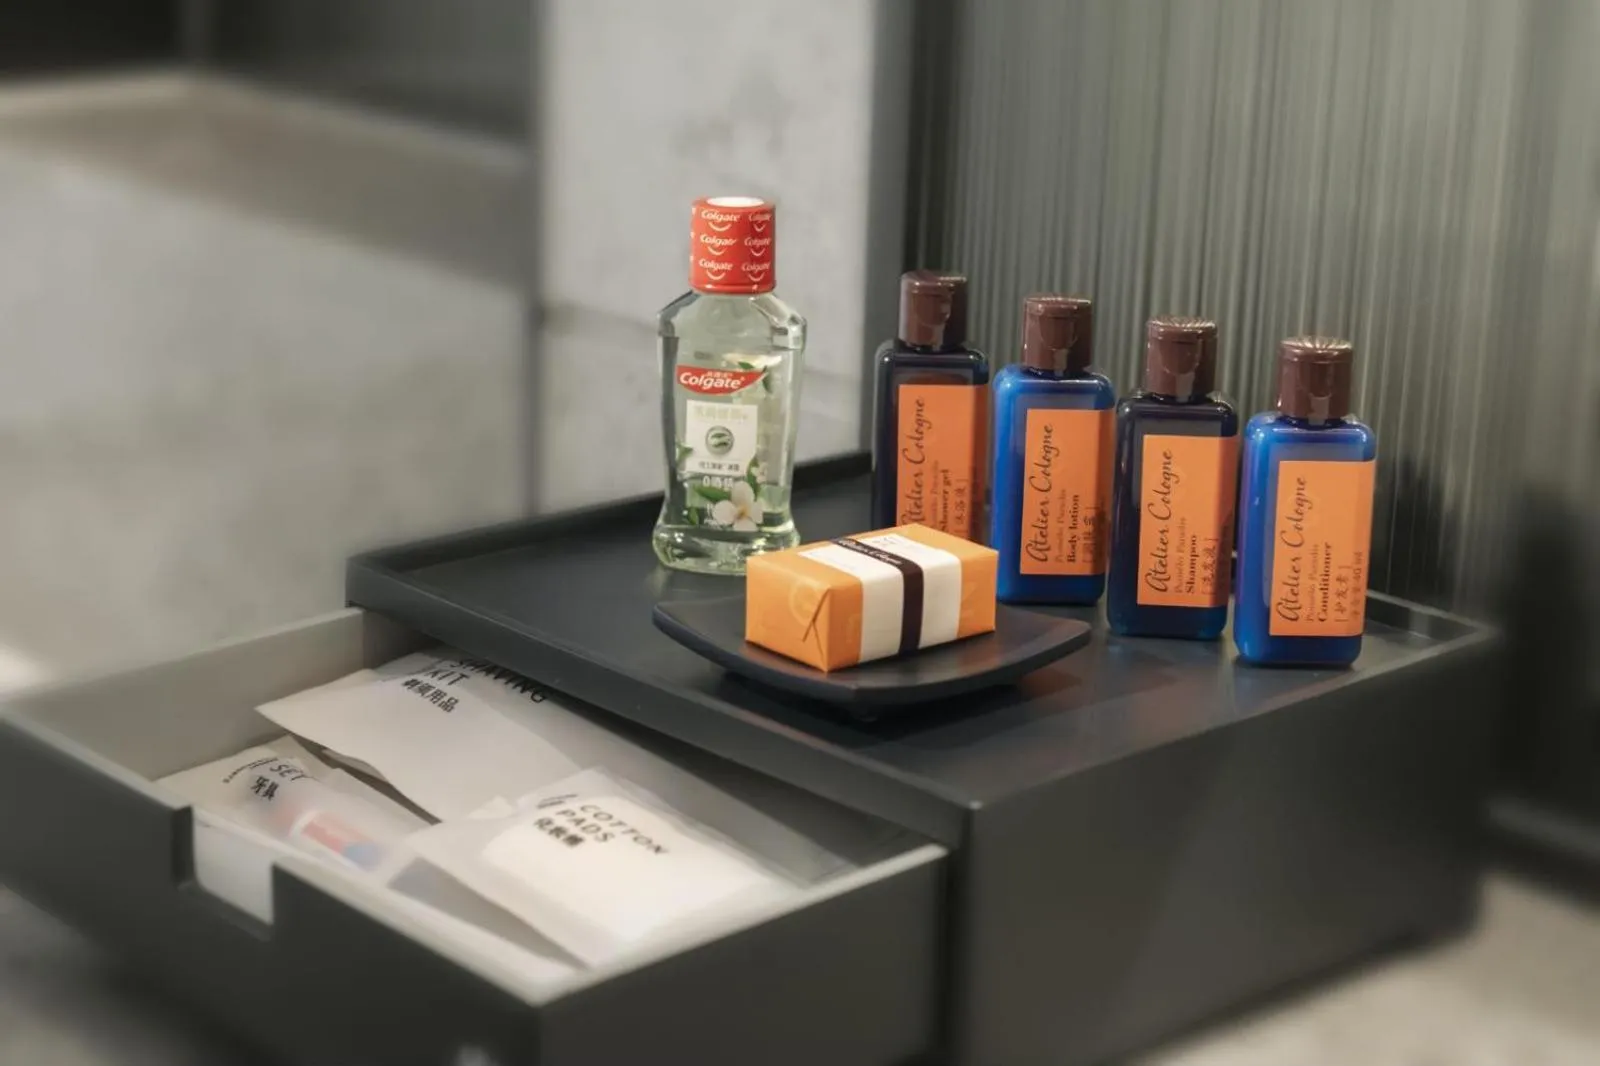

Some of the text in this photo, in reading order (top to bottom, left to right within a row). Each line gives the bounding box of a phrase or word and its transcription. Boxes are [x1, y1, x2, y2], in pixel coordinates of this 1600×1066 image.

[701, 209, 740, 222] Colgate
[700, 234, 737, 247] Colgate
[699, 258, 734, 271] Colgate
[679, 372, 742, 390] Colgate
[902, 398, 932, 464] Cologne
[939, 469, 951, 487] gel
[1025, 424, 1059, 562] Atelier Cologne
[1067, 494, 1080, 563] Body lotion
[1144, 450, 1179, 592] Atelier Cologne
[1185, 535, 1199, 594] Shampoo
[1276, 475, 1313, 622] Atelier Cologne
[1318, 542, 1332, 623] Conditioner
[426, 669, 470, 686] KIT
[269, 763, 306, 782] SET
[555, 809, 615, 842] PADS
[580, 805, 669, 855] COTTON
